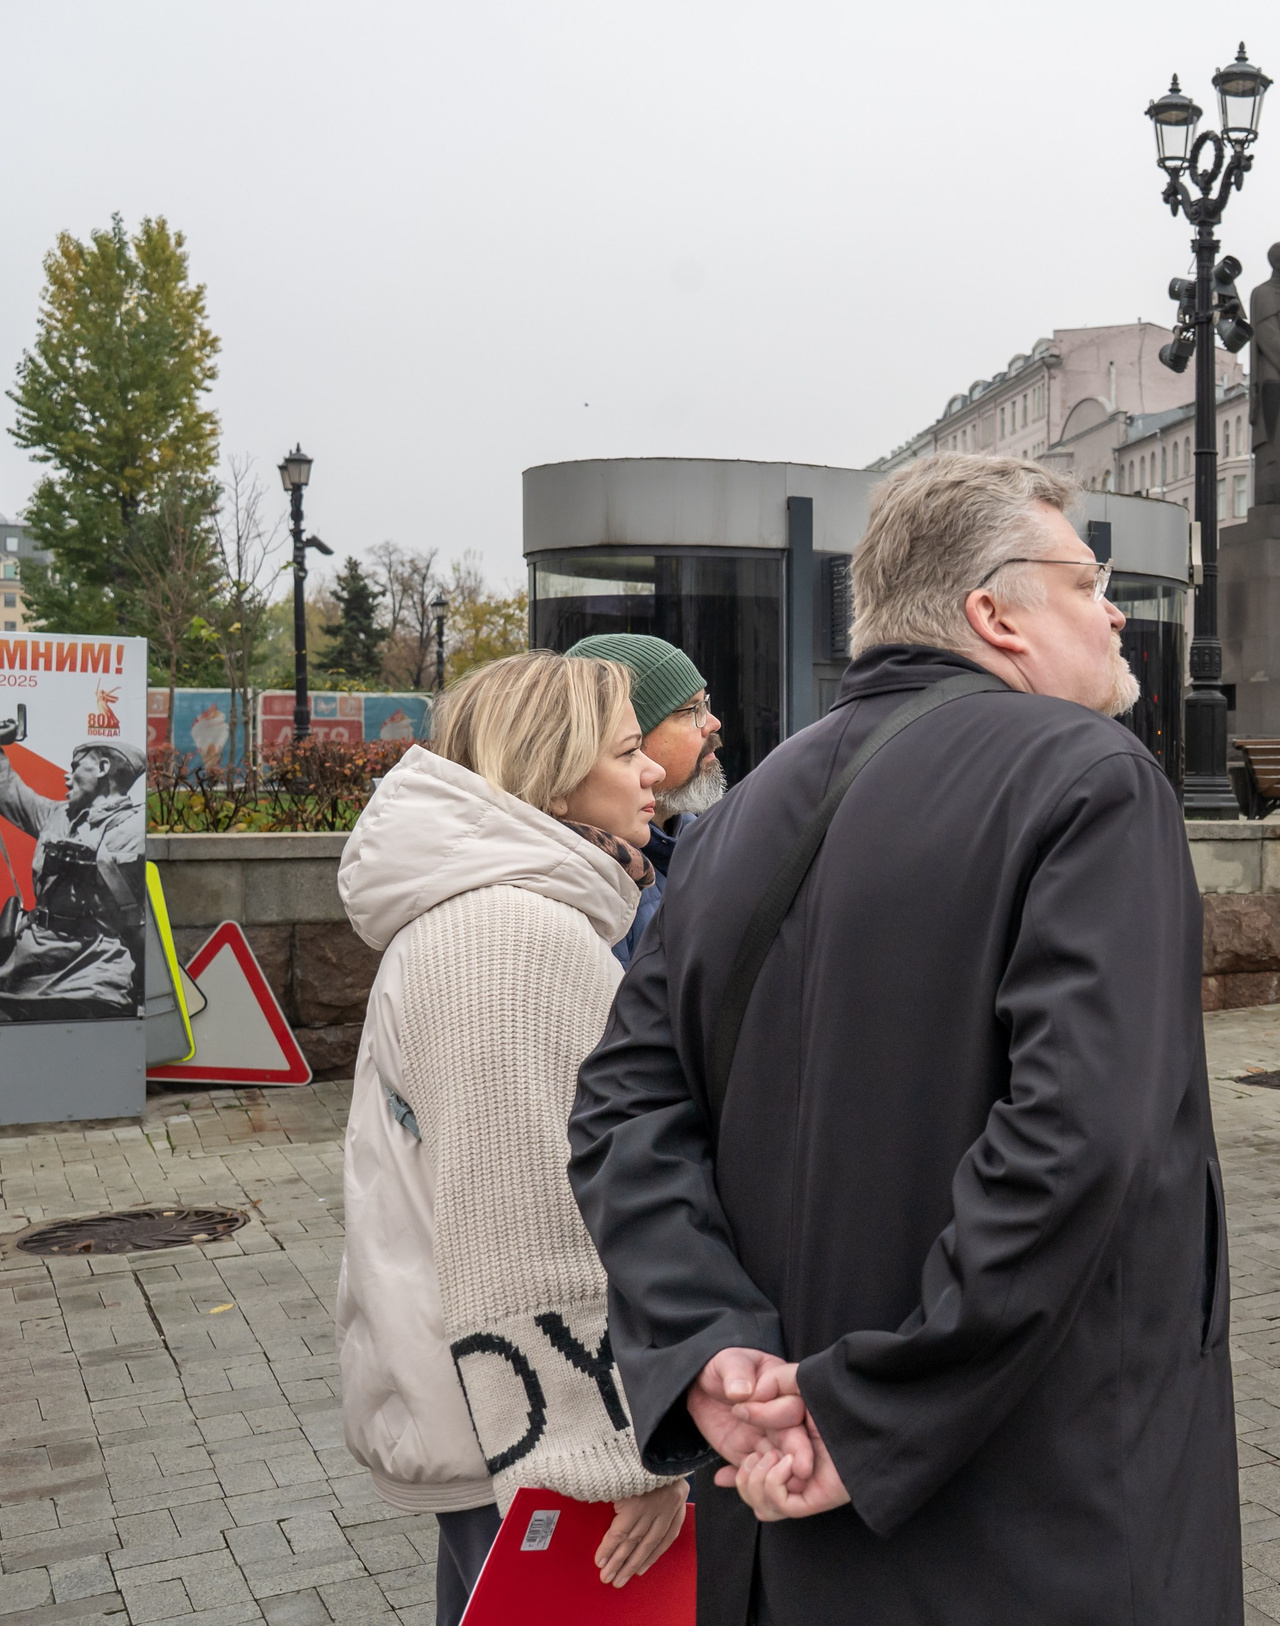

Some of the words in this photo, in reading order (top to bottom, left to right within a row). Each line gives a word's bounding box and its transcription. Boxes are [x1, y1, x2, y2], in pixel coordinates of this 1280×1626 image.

[0, 639, 125, 675] МНИМ!
[0, 675, 38, 687] 2025
[88, 713, 107, 728] 80
[87, 728, 121, 737] ПОБЕДА!
[278, 725, 350, 745] ЛТО
